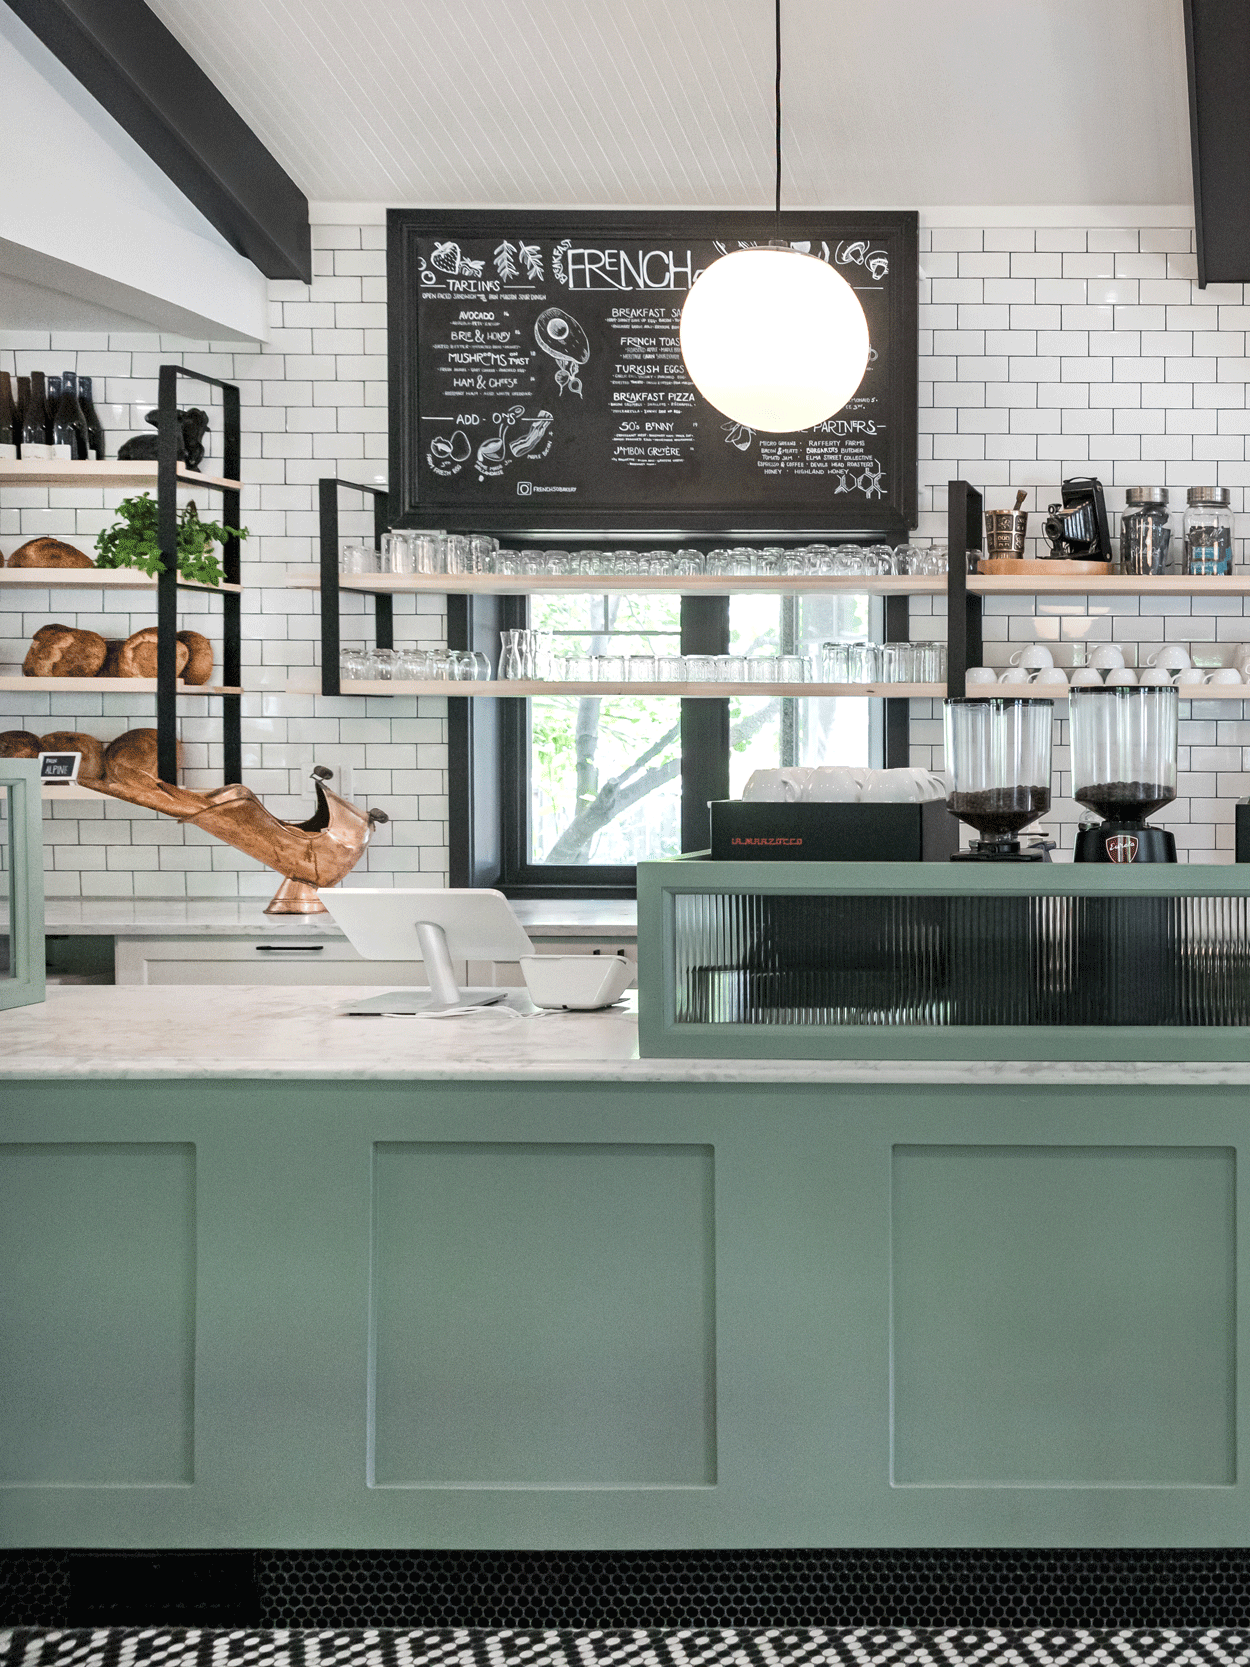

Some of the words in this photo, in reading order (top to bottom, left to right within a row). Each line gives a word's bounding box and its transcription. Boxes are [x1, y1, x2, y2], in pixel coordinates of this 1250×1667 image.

[552, 239, 571, 284] BREAKFAST
[567, 249, 692, 290] FRENCH
[446, 280, 500, 292] TARTINES
[459, 311, 494, 320] AVOCADO
[612, 308, 666, 318] BREAKFAST
[475, 329, 485, 343] &
[620, 337, 656, 347] FRENCH
[659, 337, 681, 346] TOAS
[448, 352, 507, 366] MUSHROOMS
[615, 364, 660, 375] TURKISH
[664, 364, 685, 373] EGGS
[454, 378, 474, 387] HAM
[476, 375, 486, 389] &
[489, 378, 518, 388] CHEESE
[613, 393, 665, 403] BREAKFAST
[668, 393, 695, 401] PIZZA
[456, 414, 480, 425] ADD
[645, 422, 674, 431] BENNY
[813, 420, 877, 436] PARTNERS
[614, 447, 645, 455] JAMBON
[45, 765, 68, 775] ALPINE
